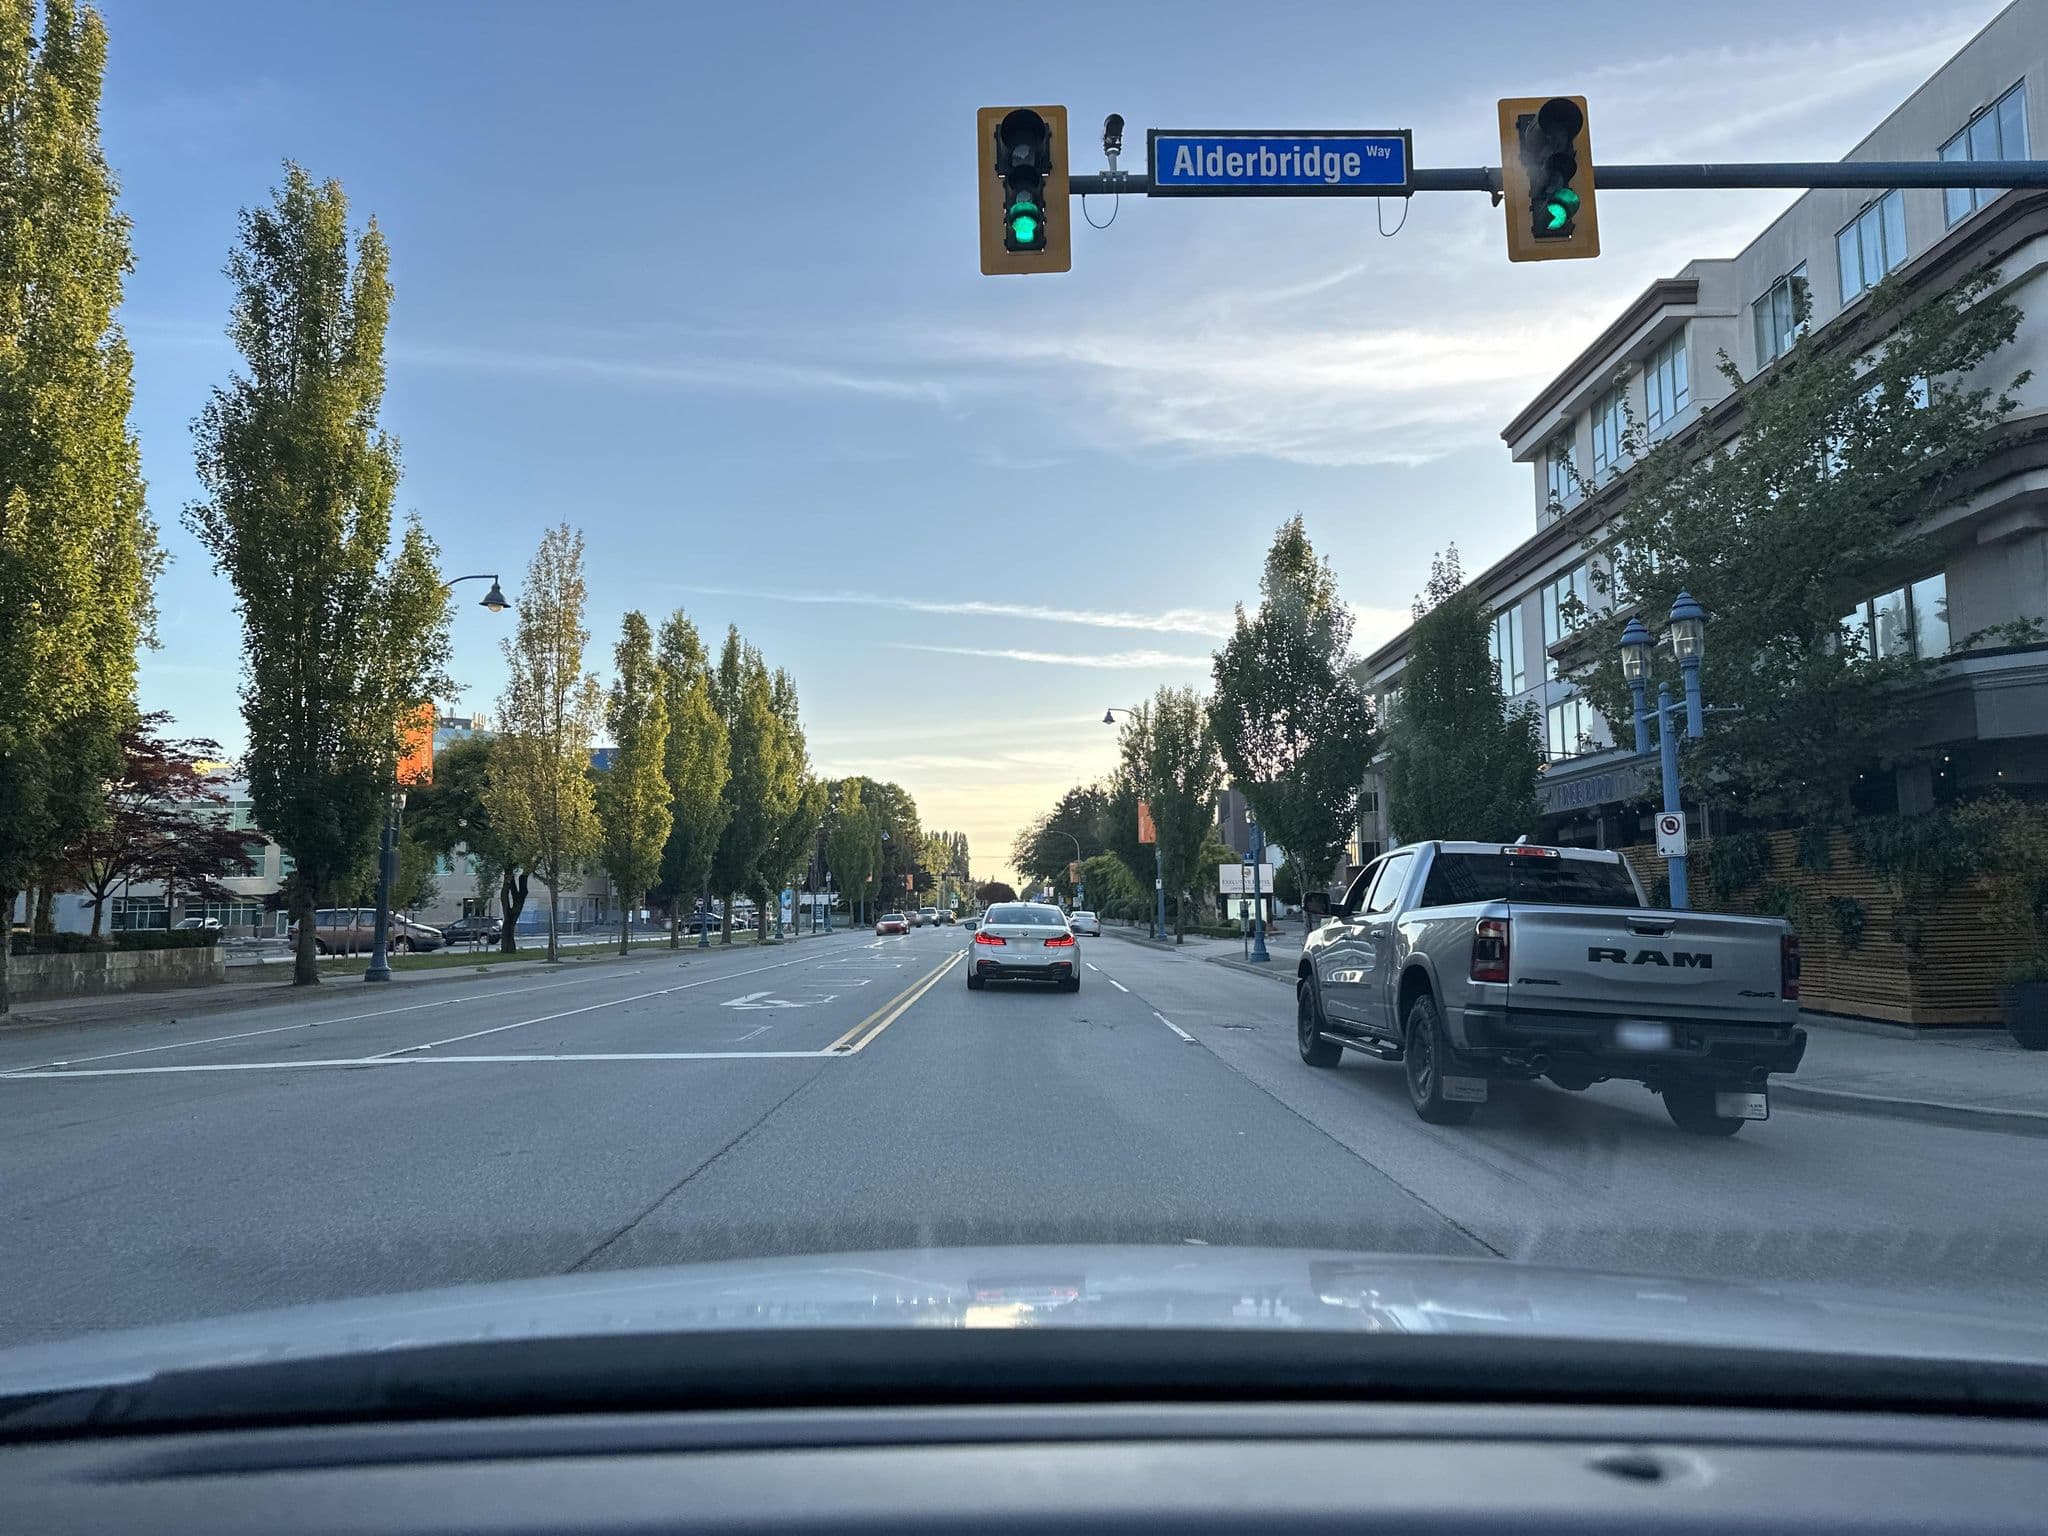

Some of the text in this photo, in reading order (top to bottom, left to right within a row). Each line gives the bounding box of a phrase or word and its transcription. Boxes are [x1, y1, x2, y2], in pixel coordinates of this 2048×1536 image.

[1172, 145, 1391, 184] Alderbridge Way
[1588, 947, 1713, 970] RAM
